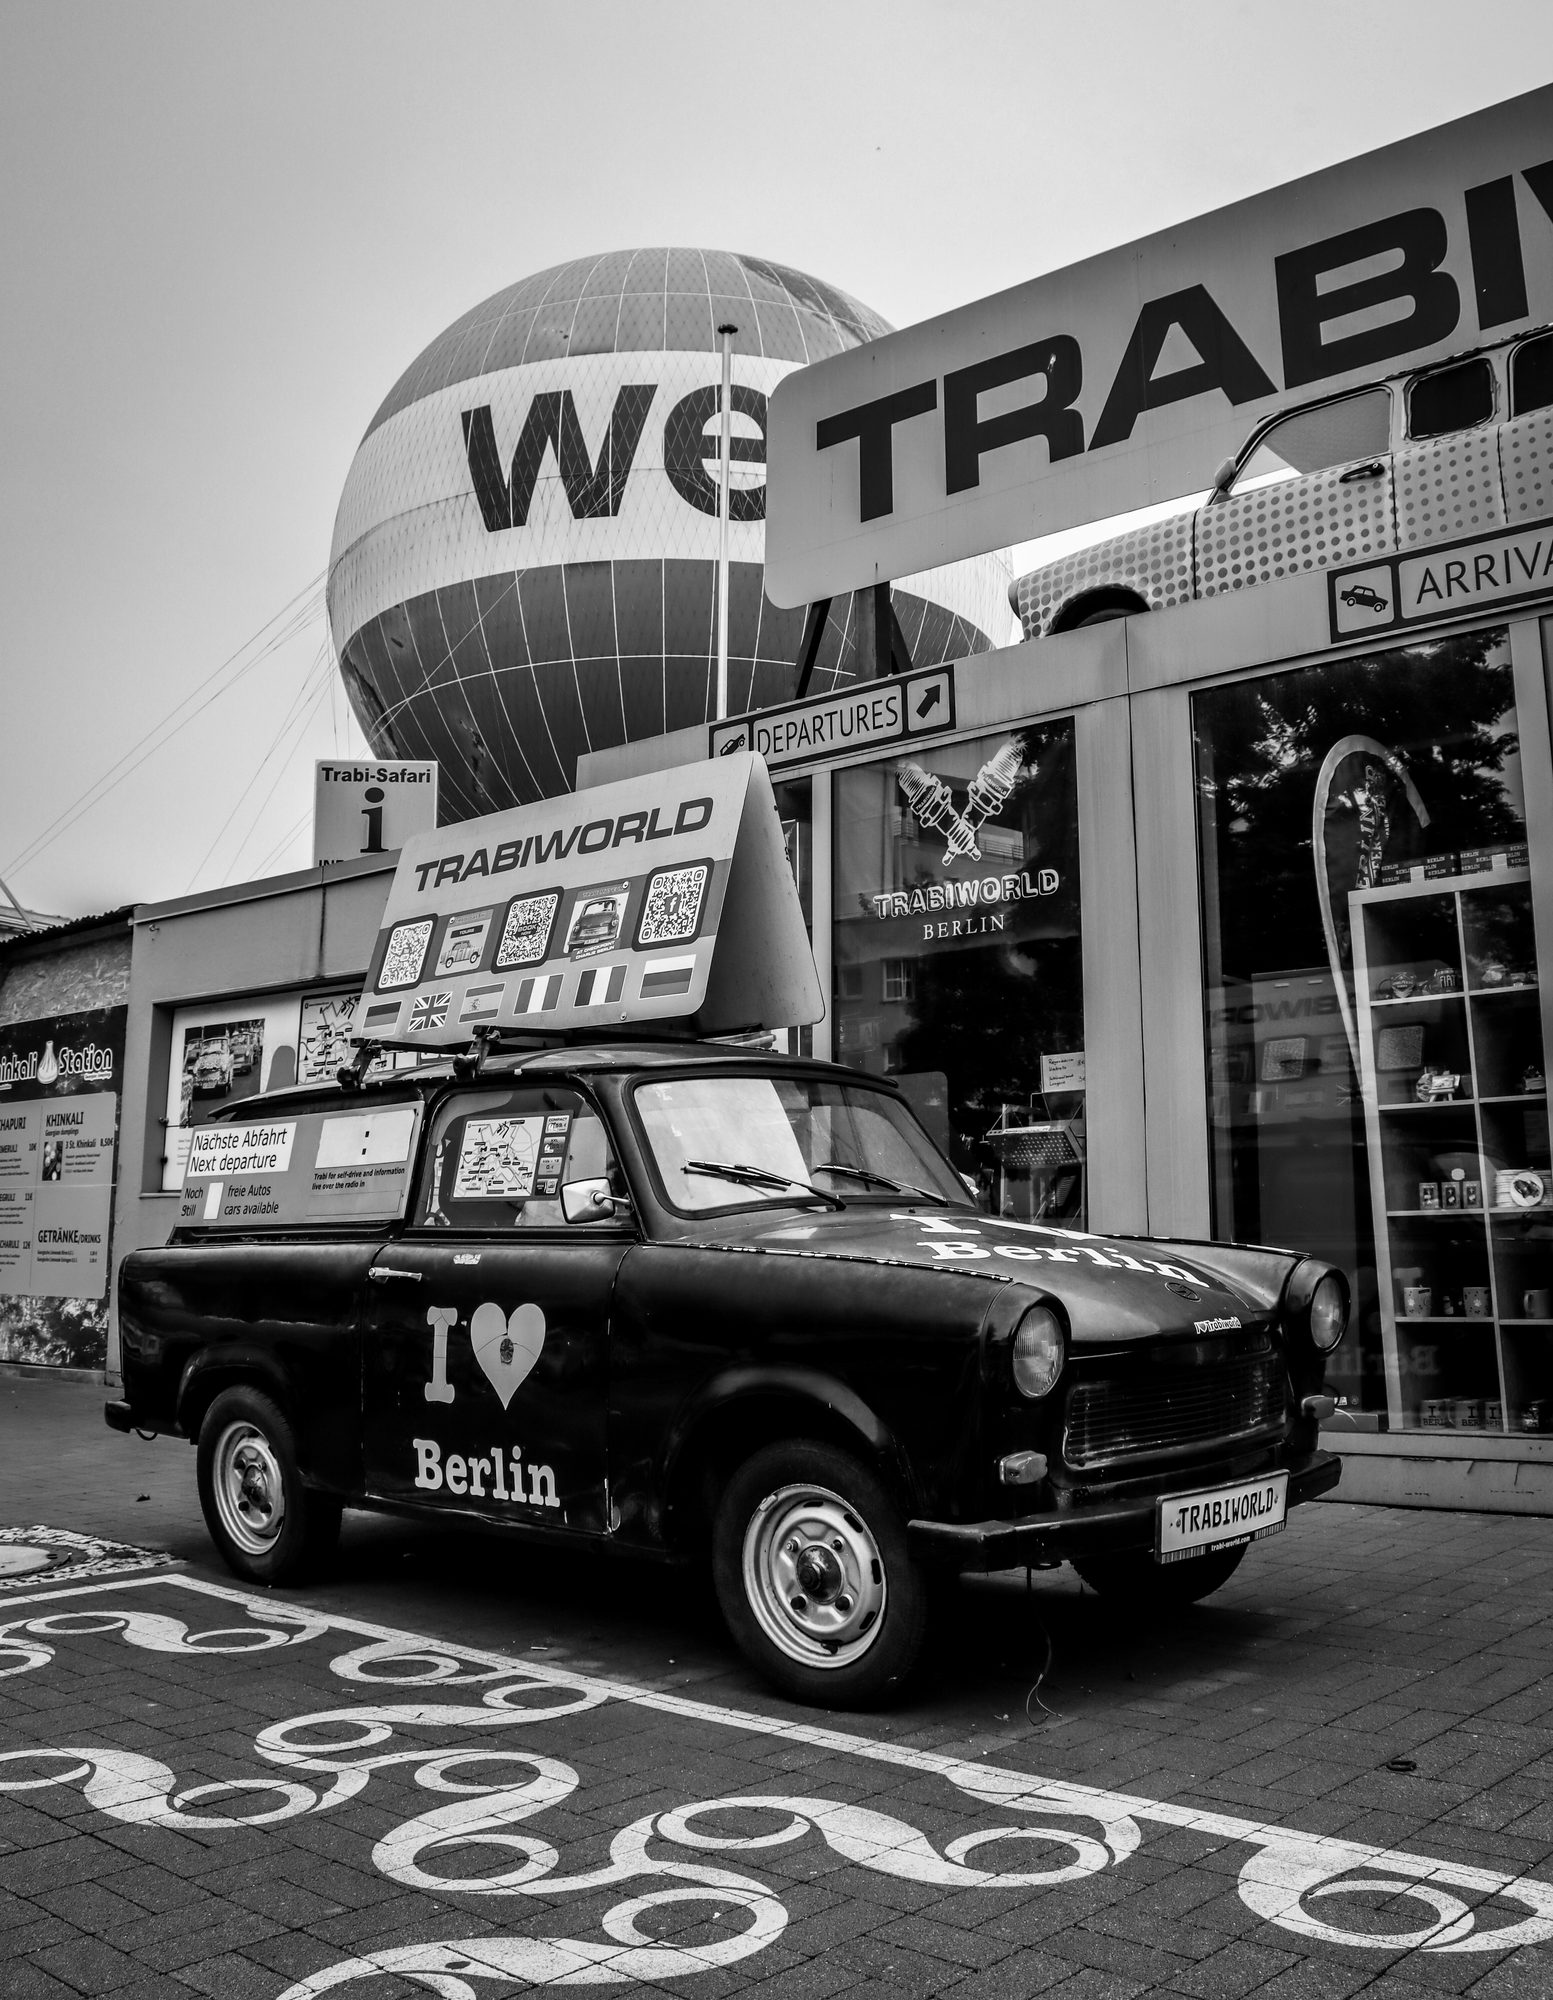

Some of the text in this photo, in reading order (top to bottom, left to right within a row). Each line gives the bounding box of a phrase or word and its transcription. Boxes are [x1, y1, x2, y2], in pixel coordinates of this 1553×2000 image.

[756, 695, 900, 757] DEPARTURES
[322, 767, 431, 783] Trabi-Safari
[415, 796, 715, 892] TRABIWORLD
[873, 868, 1060, 920] TRABIWORLD
[923, 914, 1005, 940] BERLIN
[0, 1043, 113, 1083] inkali Station
[46, 1111, 84, 1127] KHINKALI
[194, 1128, 287, 1151] Nächste Abfahrt
[190, 1154, 277, 1174] Next departure
[314, 1166, 405, 1180] Trabi for self-drive and information
[184, 1184, 271, 1199] Noch freie Autos
[335, 1181, 344, 1189] the
[345, 1180, 358, 1188] radio
[181, 1202, 279, 1216] Still cars available
[917, 1242, 1209, 1288] Berlin
[425, 1306, 458, 1403] I
[413, 1438, 560, 1507] Berlin
[1179, 1487, 1274, 1534] TRABIWORLD
[1211, 1535, 1250, 1551] trabi-world.com
